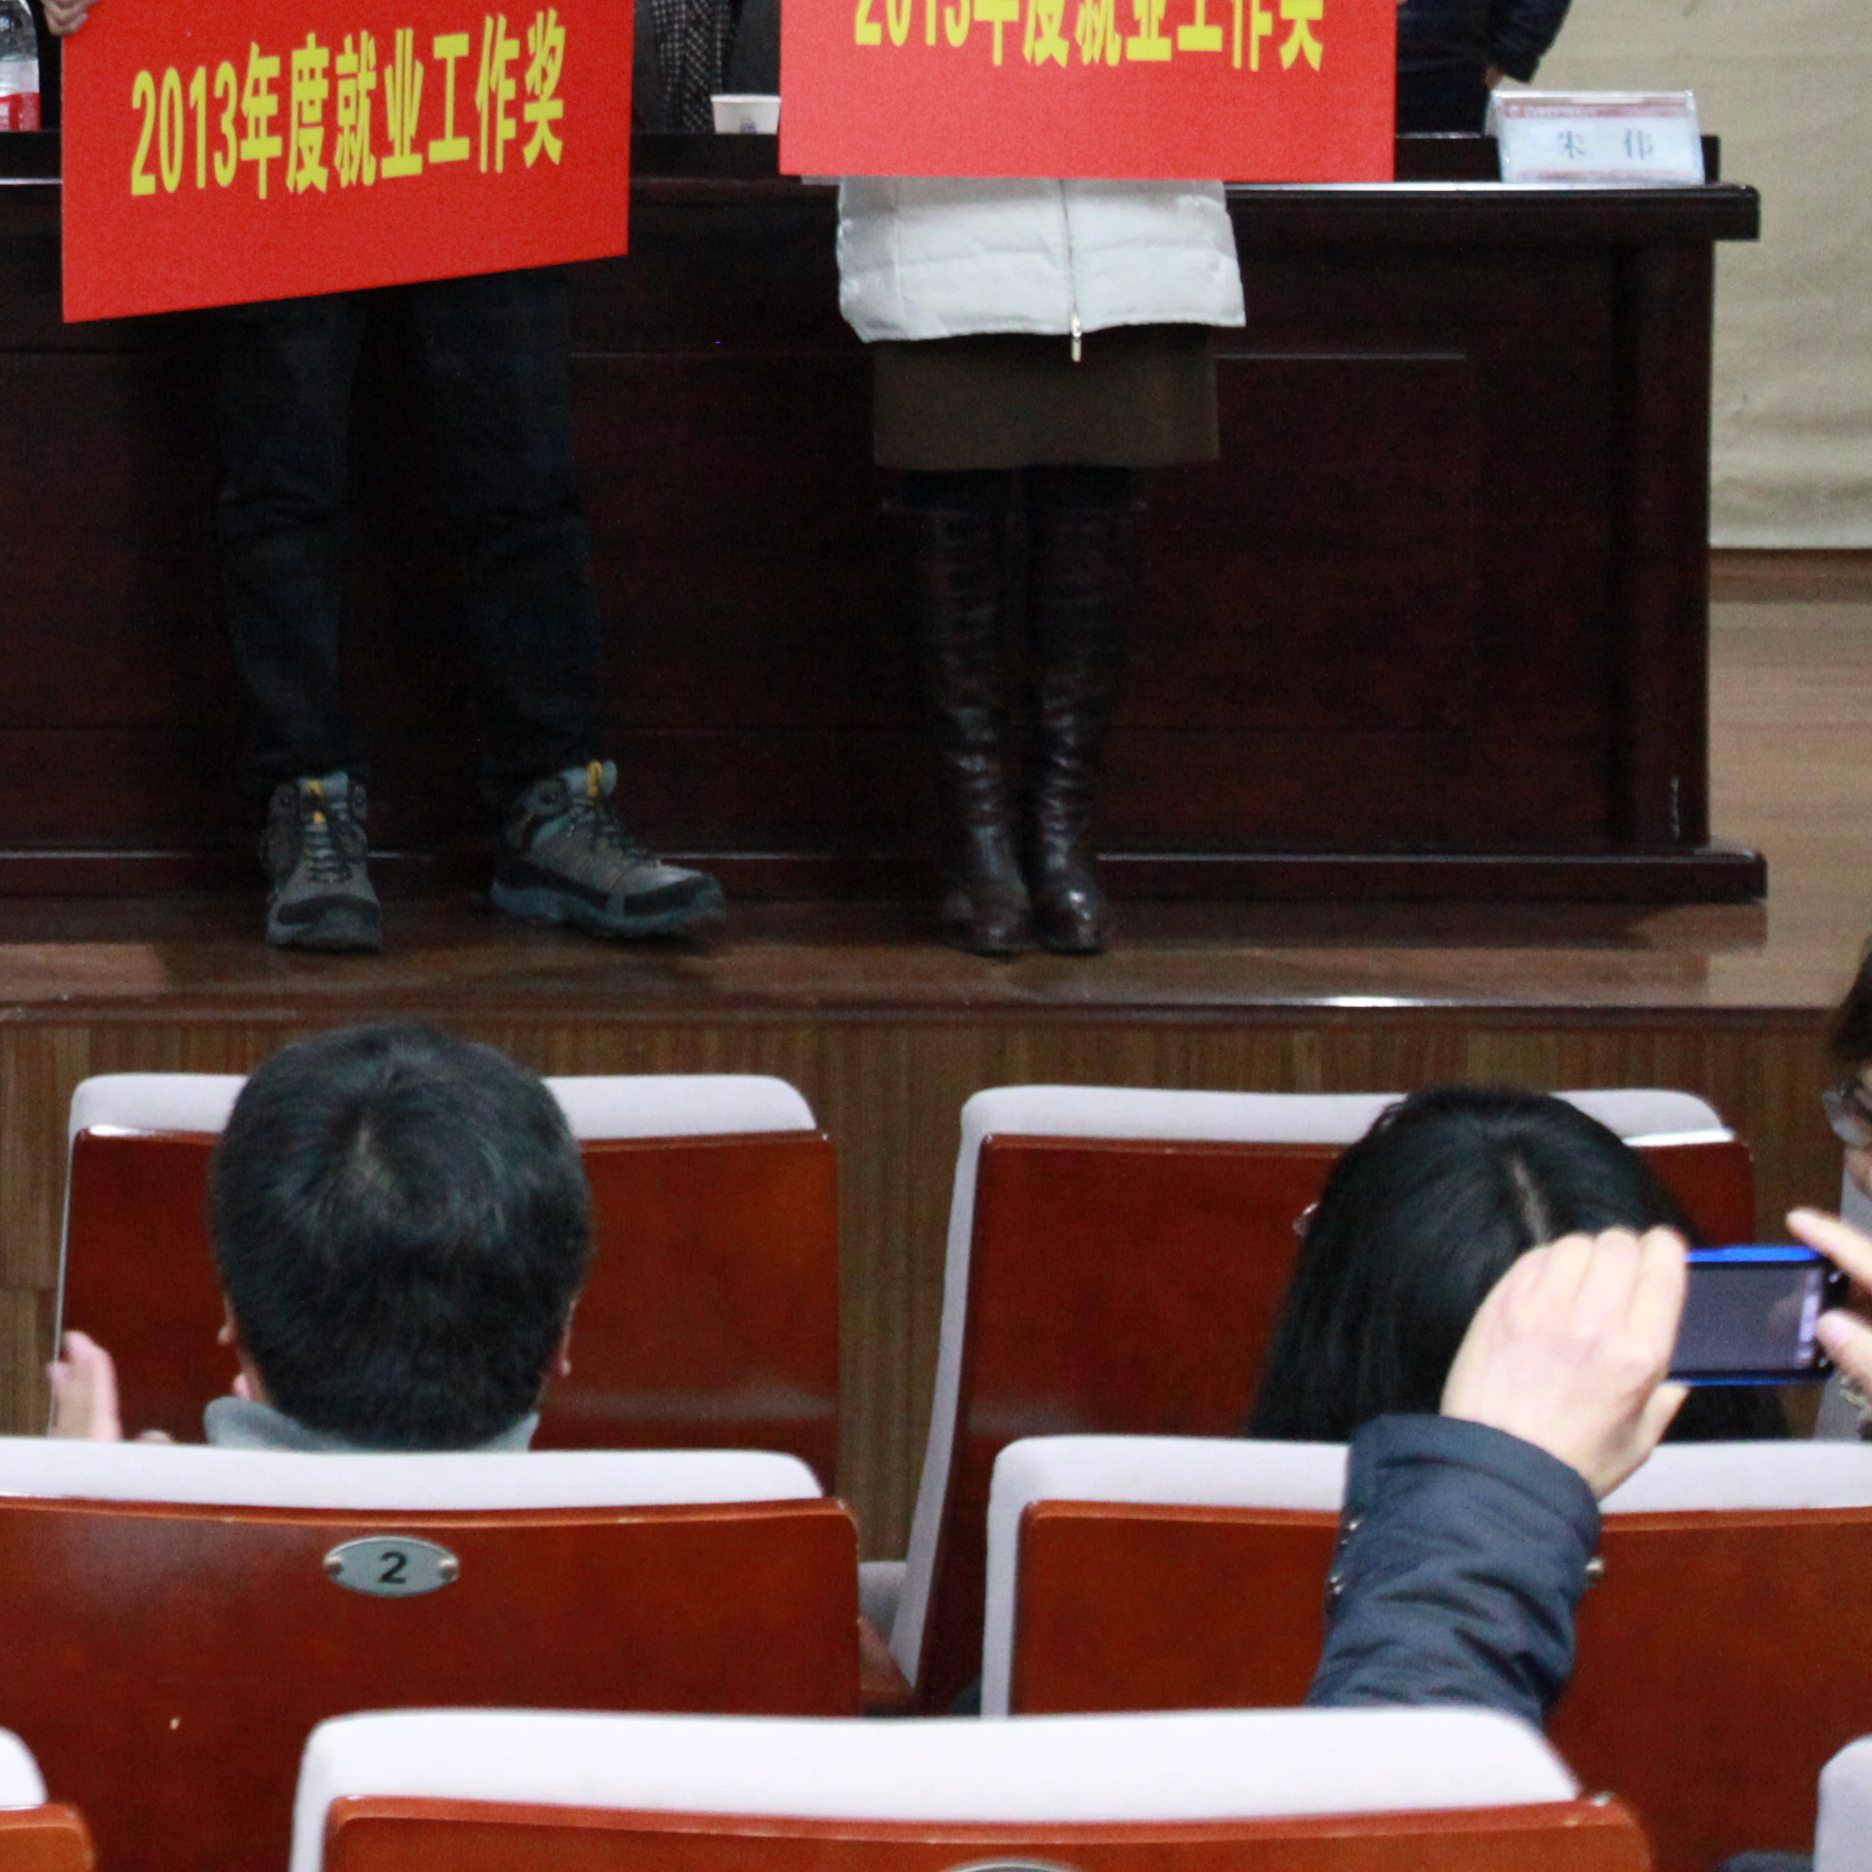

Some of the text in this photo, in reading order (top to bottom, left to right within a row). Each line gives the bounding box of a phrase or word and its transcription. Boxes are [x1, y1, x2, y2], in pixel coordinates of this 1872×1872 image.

[131, 8, 566, 199] 2013年度就业工作奖
[378, 1551, 408, 1585] 2
